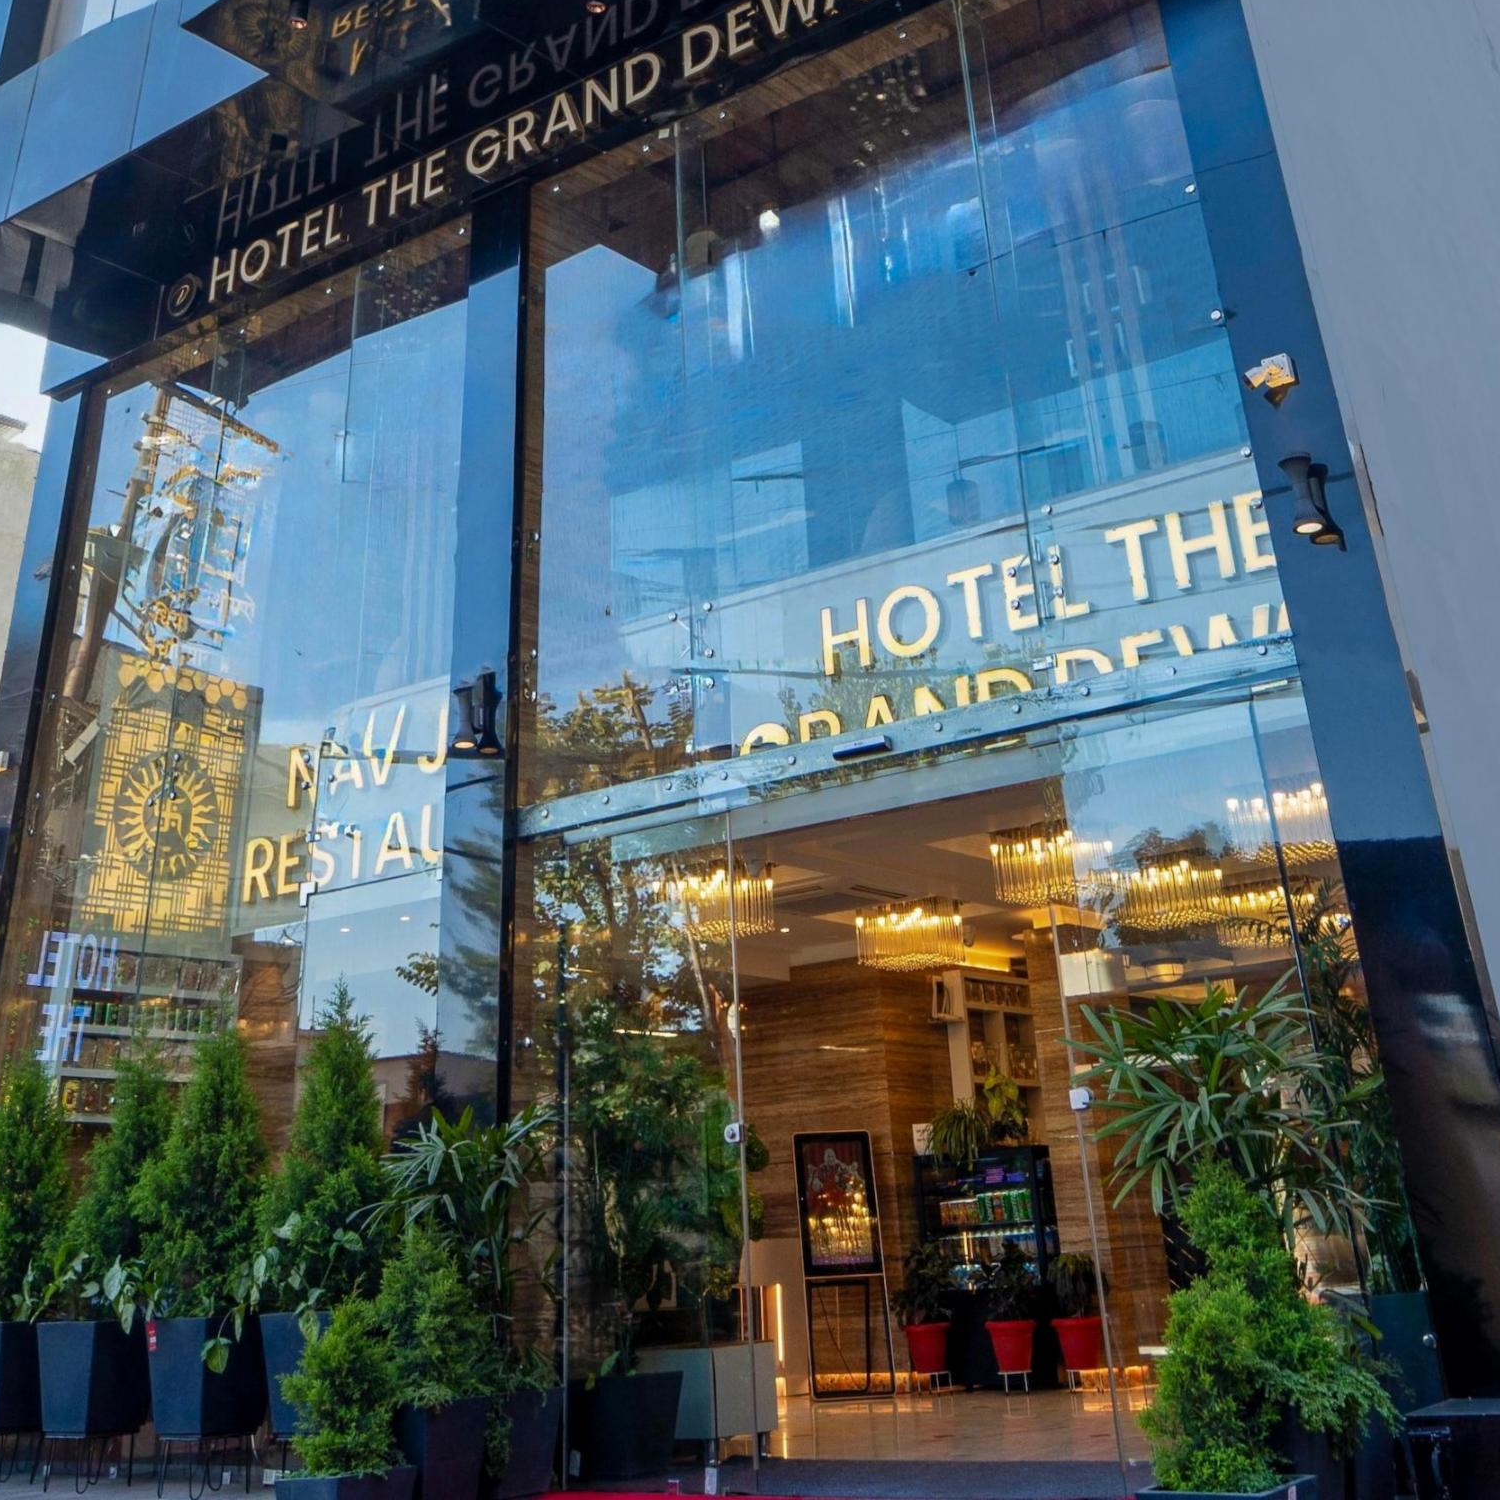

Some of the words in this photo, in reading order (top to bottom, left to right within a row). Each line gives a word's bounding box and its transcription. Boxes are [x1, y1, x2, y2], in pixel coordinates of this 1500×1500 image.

[208, 203, 341, 302] HOTEL
[362, 149, 447, 227] THE
[465, 51, 661, 176] GRAND
[820, 544, 1090, 677] HOTEL
[1104, 490, 1277, 601] THE
